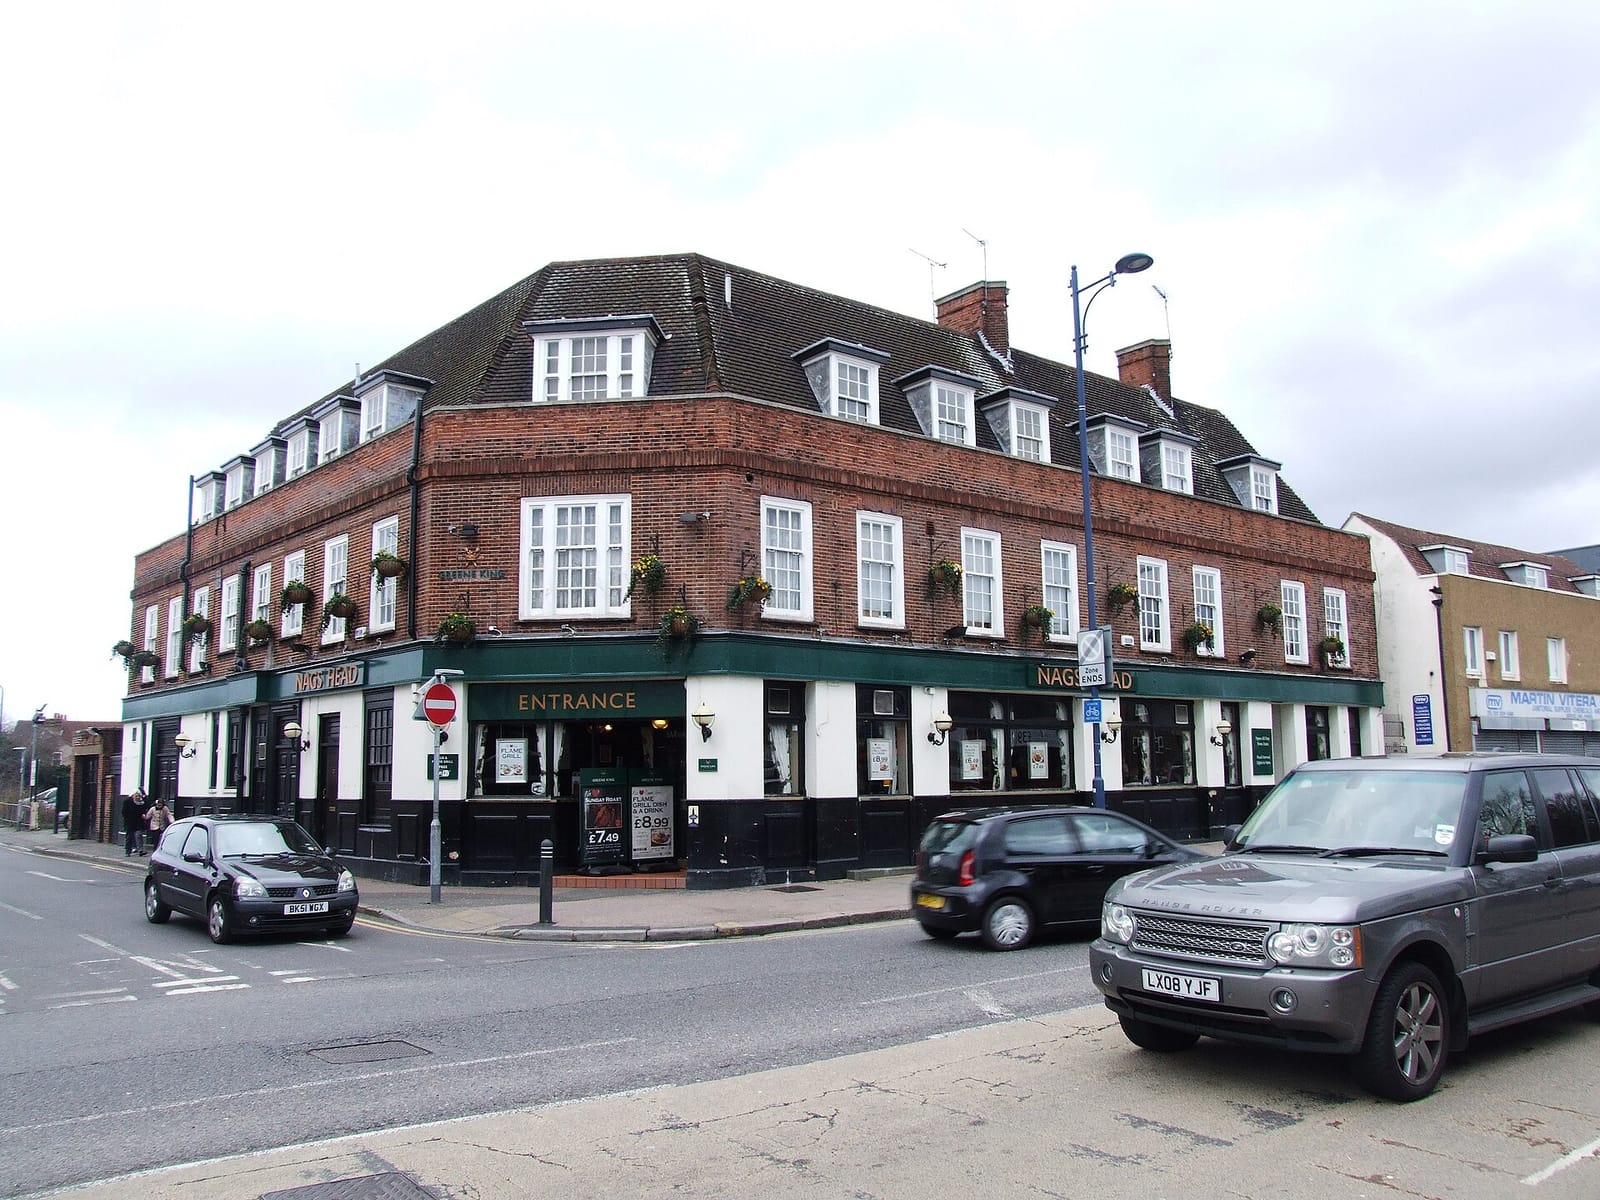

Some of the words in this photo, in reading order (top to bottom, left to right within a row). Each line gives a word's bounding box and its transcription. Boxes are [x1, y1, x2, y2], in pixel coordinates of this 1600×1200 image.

[480, 570, 505, 579] KING
[296, 671, 323, 692] NAGS
[327, 664, 359, 687] HEAD
[1081, 674, 1103, 683] ENDS
[1112, 672, 1133, 689] AD
[518, 692, 637, 711] ENTRANCE
[1510, 691, 1554, 705] MARTIN
[589, 830, 619, 844] £7.49
[289, 904, 307, 913] BK51
[309, 903, 324, 912] WGX
[1148, 972, 1180, 992] LX08
[1183, 979, 1211, 996] YJF
